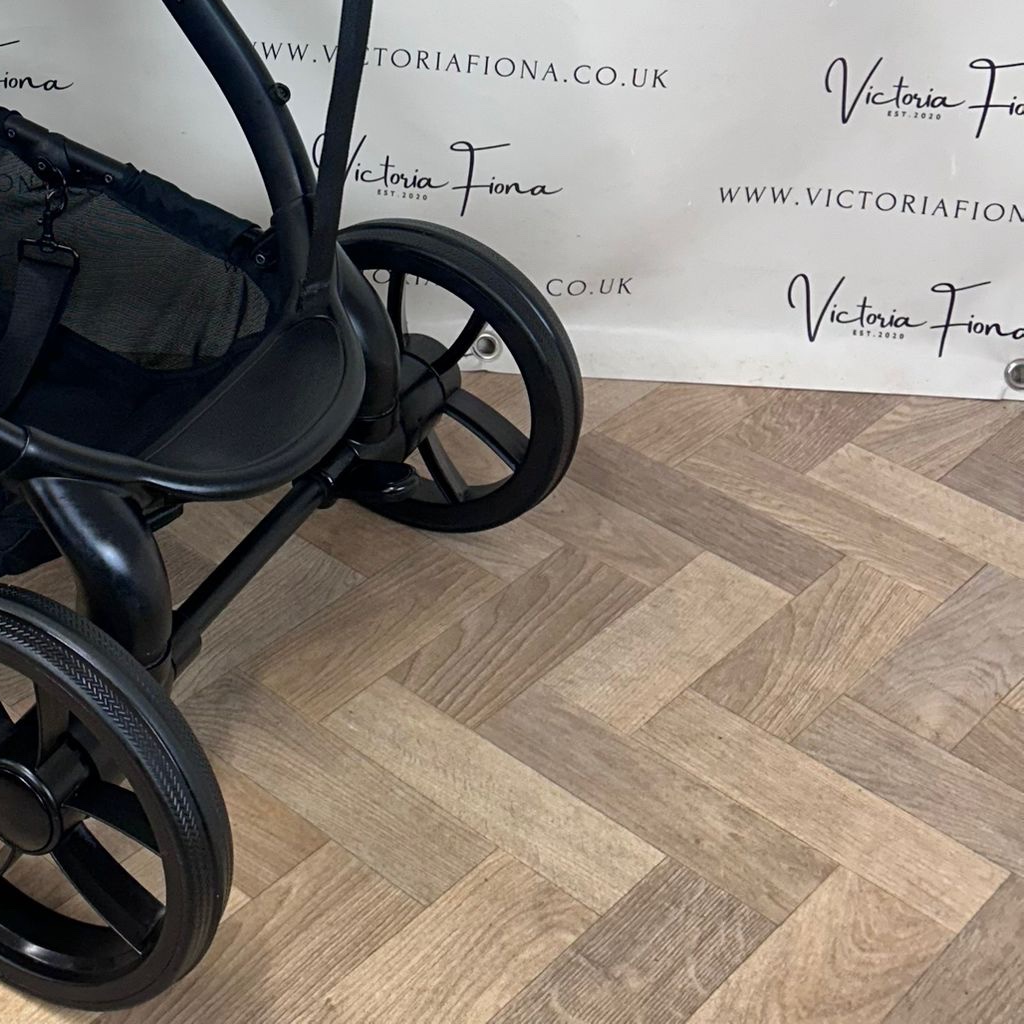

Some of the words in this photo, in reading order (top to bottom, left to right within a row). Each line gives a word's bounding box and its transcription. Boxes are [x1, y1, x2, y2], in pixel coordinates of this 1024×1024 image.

[824, 57, 966, 124] Victoria
[968, 58, 1024, 139] Fio
[887, 110, 941, 120] EST.2020
[377, 189, 427, 200] EST.2020
[450, 141, 563, 217] Fiona
[720, 186, 1024, 222] WWW.VICTORIAFION
[787, 273, 928, 343] Victoria
[852, 329, 904, 339] EST.2020
